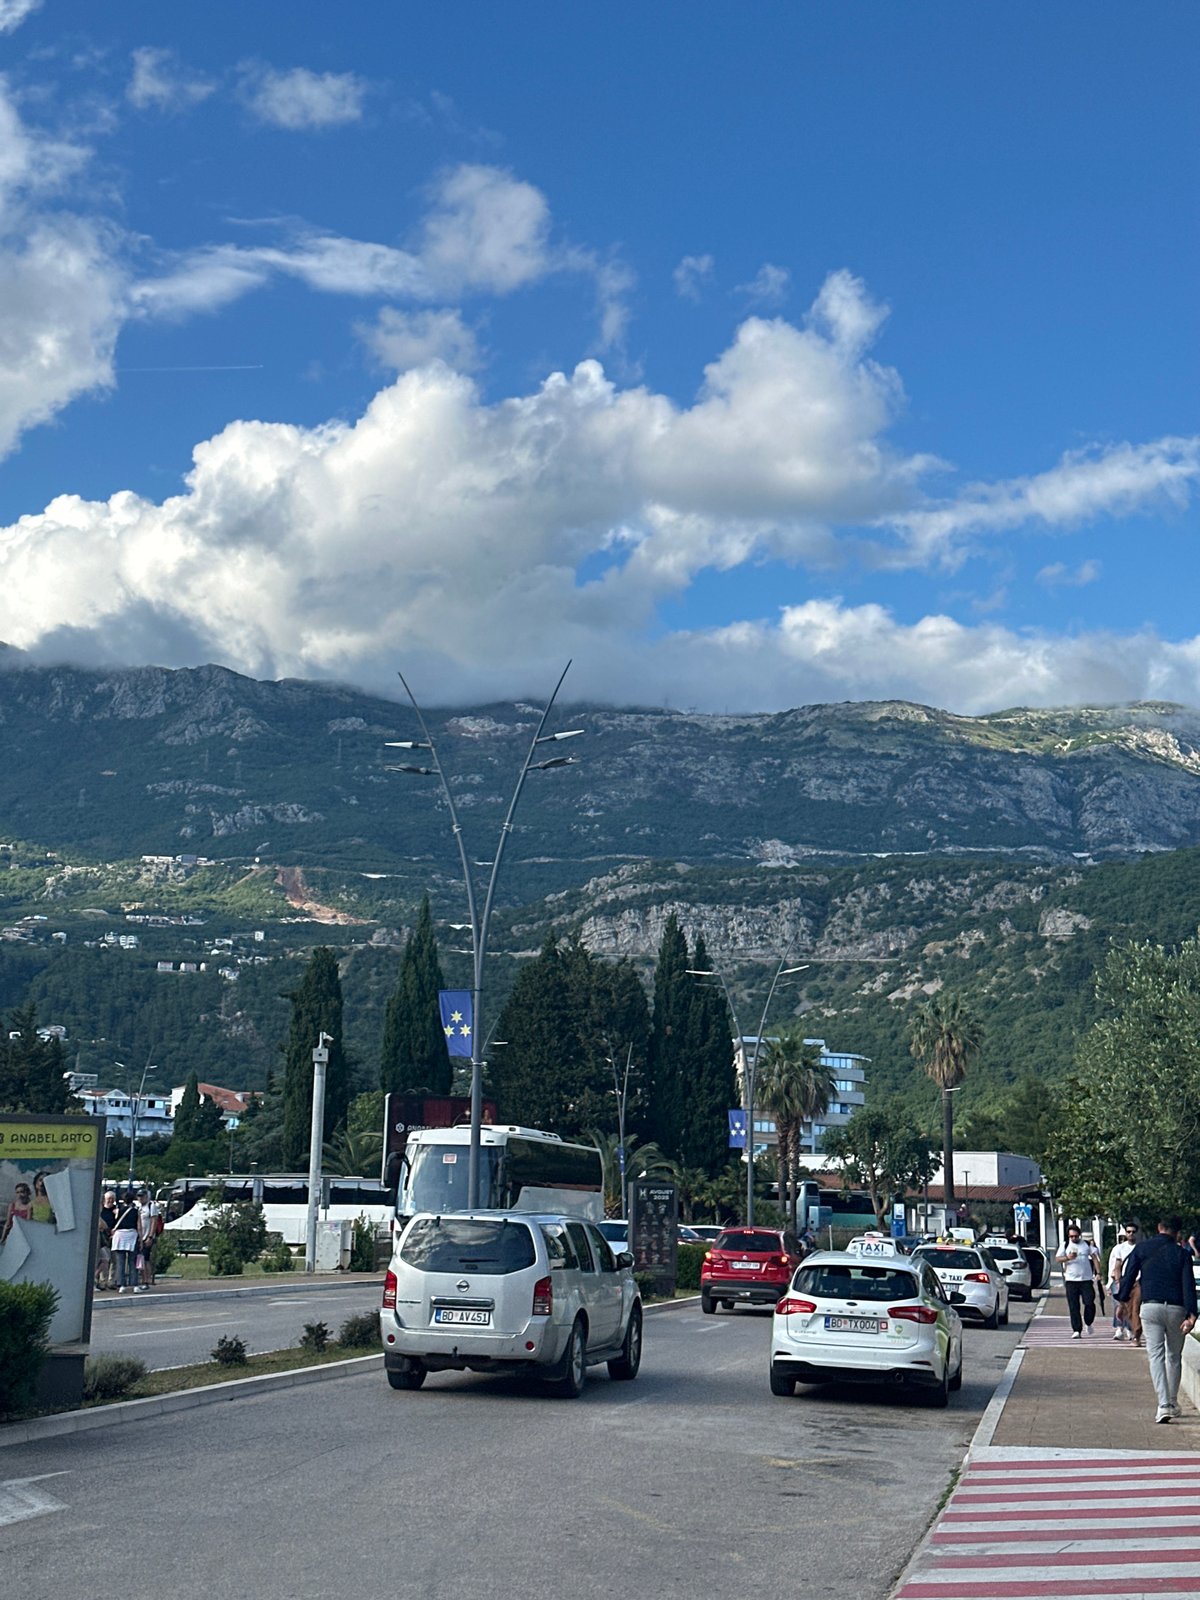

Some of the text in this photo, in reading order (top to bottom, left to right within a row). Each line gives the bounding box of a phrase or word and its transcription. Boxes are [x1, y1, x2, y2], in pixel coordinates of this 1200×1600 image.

[11, 1133, 92, 1143] ANABEL ARTO
[859, 1243, 884, 1252] TAXI
[442, 1311, 487, 1323] BD AV451
[831, 1318, 876, 1330] BD TX004
